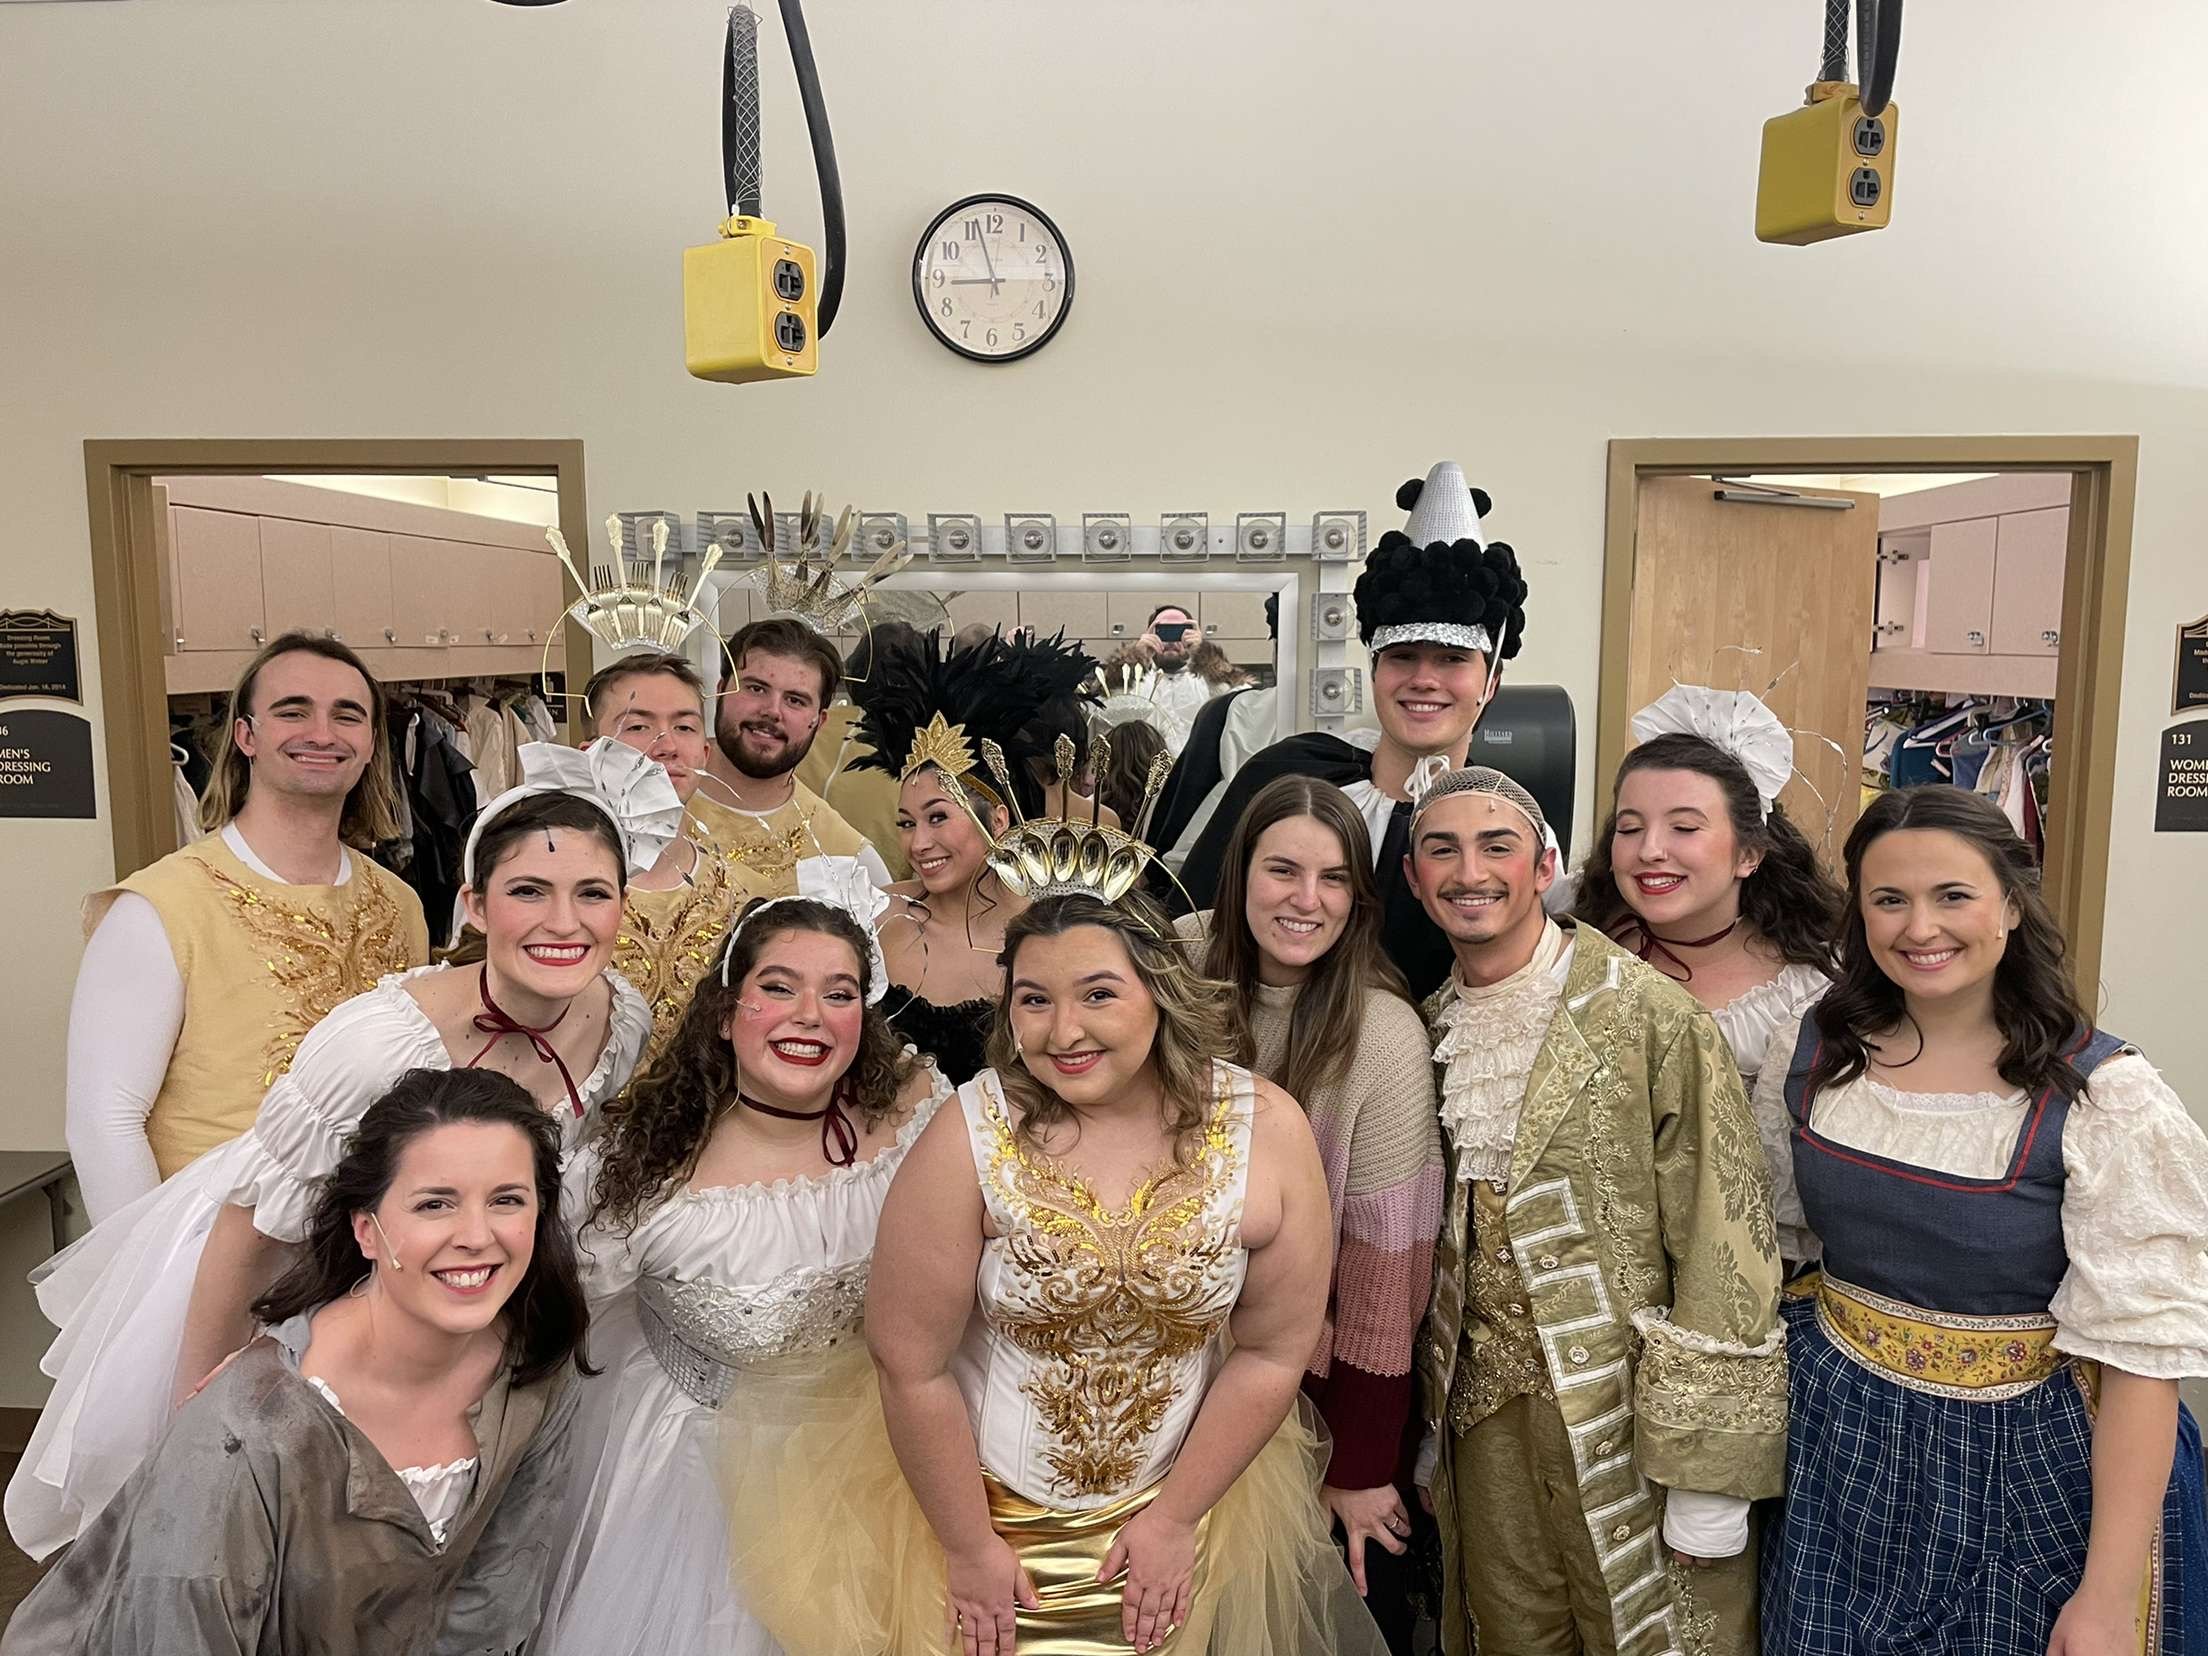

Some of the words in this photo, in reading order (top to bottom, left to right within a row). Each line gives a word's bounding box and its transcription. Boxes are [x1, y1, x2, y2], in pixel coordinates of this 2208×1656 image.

[965, 221, 977, 241] 11
[986, 214, 1003, 234] 12
[942, 241, 960, 261] 10
[1035, 244, 1047, 264] 2
[932, 269, 945, 288] 9
[1042, 272, 1056, 292] 3
[941, 297, 953, 317] 8
[1032, 300, 1046, 320] 4
[960, 320, 971, 339] 7
[986, 328, 998, 347] 6
[1012, 322, 1025, 341] 5
[2172, 734, 2191, 744] 131
[0, 748, 31, 759] MEN'S
[0, 761, 51, 773] DRESSING
[0, 773, 34, 785] ROOM
[2167, 785, 2208, 798] ROOM
